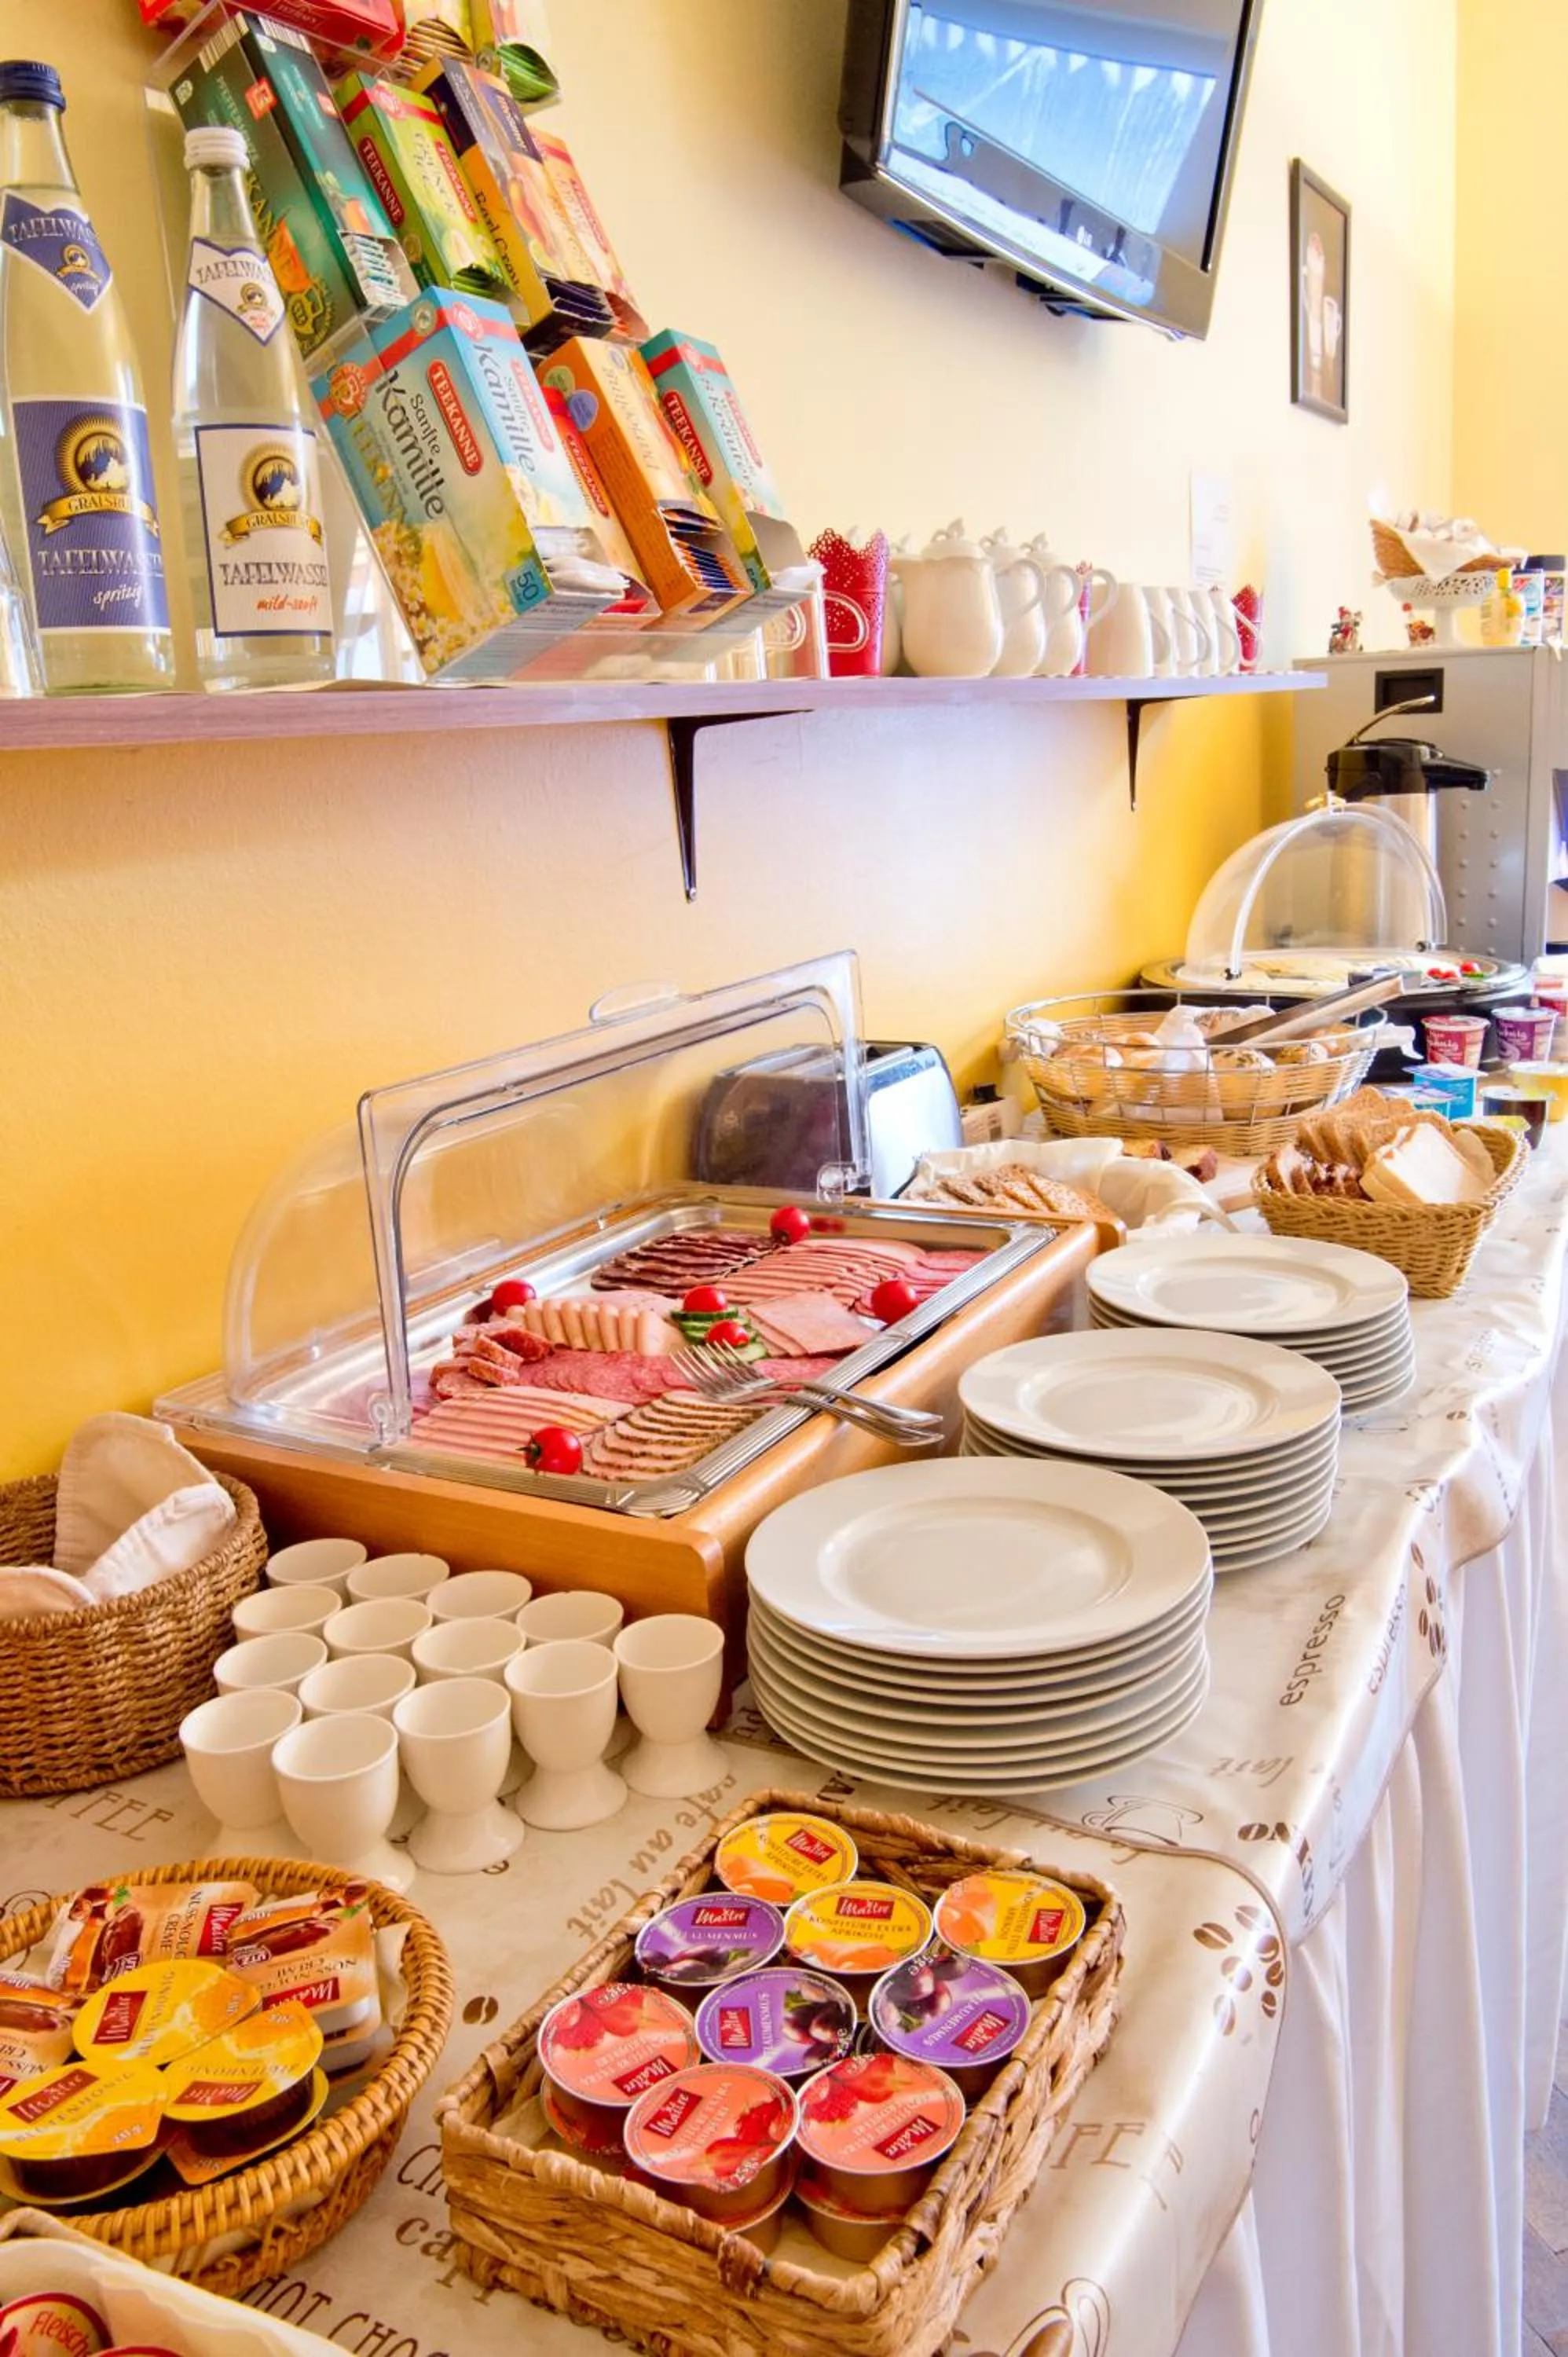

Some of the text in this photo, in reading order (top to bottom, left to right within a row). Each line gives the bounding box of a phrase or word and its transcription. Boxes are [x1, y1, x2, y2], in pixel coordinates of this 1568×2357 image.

[361, 143, 403, 224] TEEKANNE
[410, 394, 441, 455] Sanfte
[433, 365, 478, 467] TEEKANNE
[473, 344, 535, 472] Kamille
[668, 397, 710, 480] TEEKANNE
[376, 370, 445, 519] Kamille
[93, 582, 142, 610] spritzig
[516, 570, 539, 602] 50
[1279, 1594, 1346, 1707] espresso
[628, 1828, 674, 1874] au
[160, 1912, 181, 1953] CREME
[566, 1878, 643, 1941] lait
[830, 1927, 885, 1941] APRIKOSE
[877, 1923, 912, 1934] EXTRA
[328, 2312, 450, 2357] CHO
